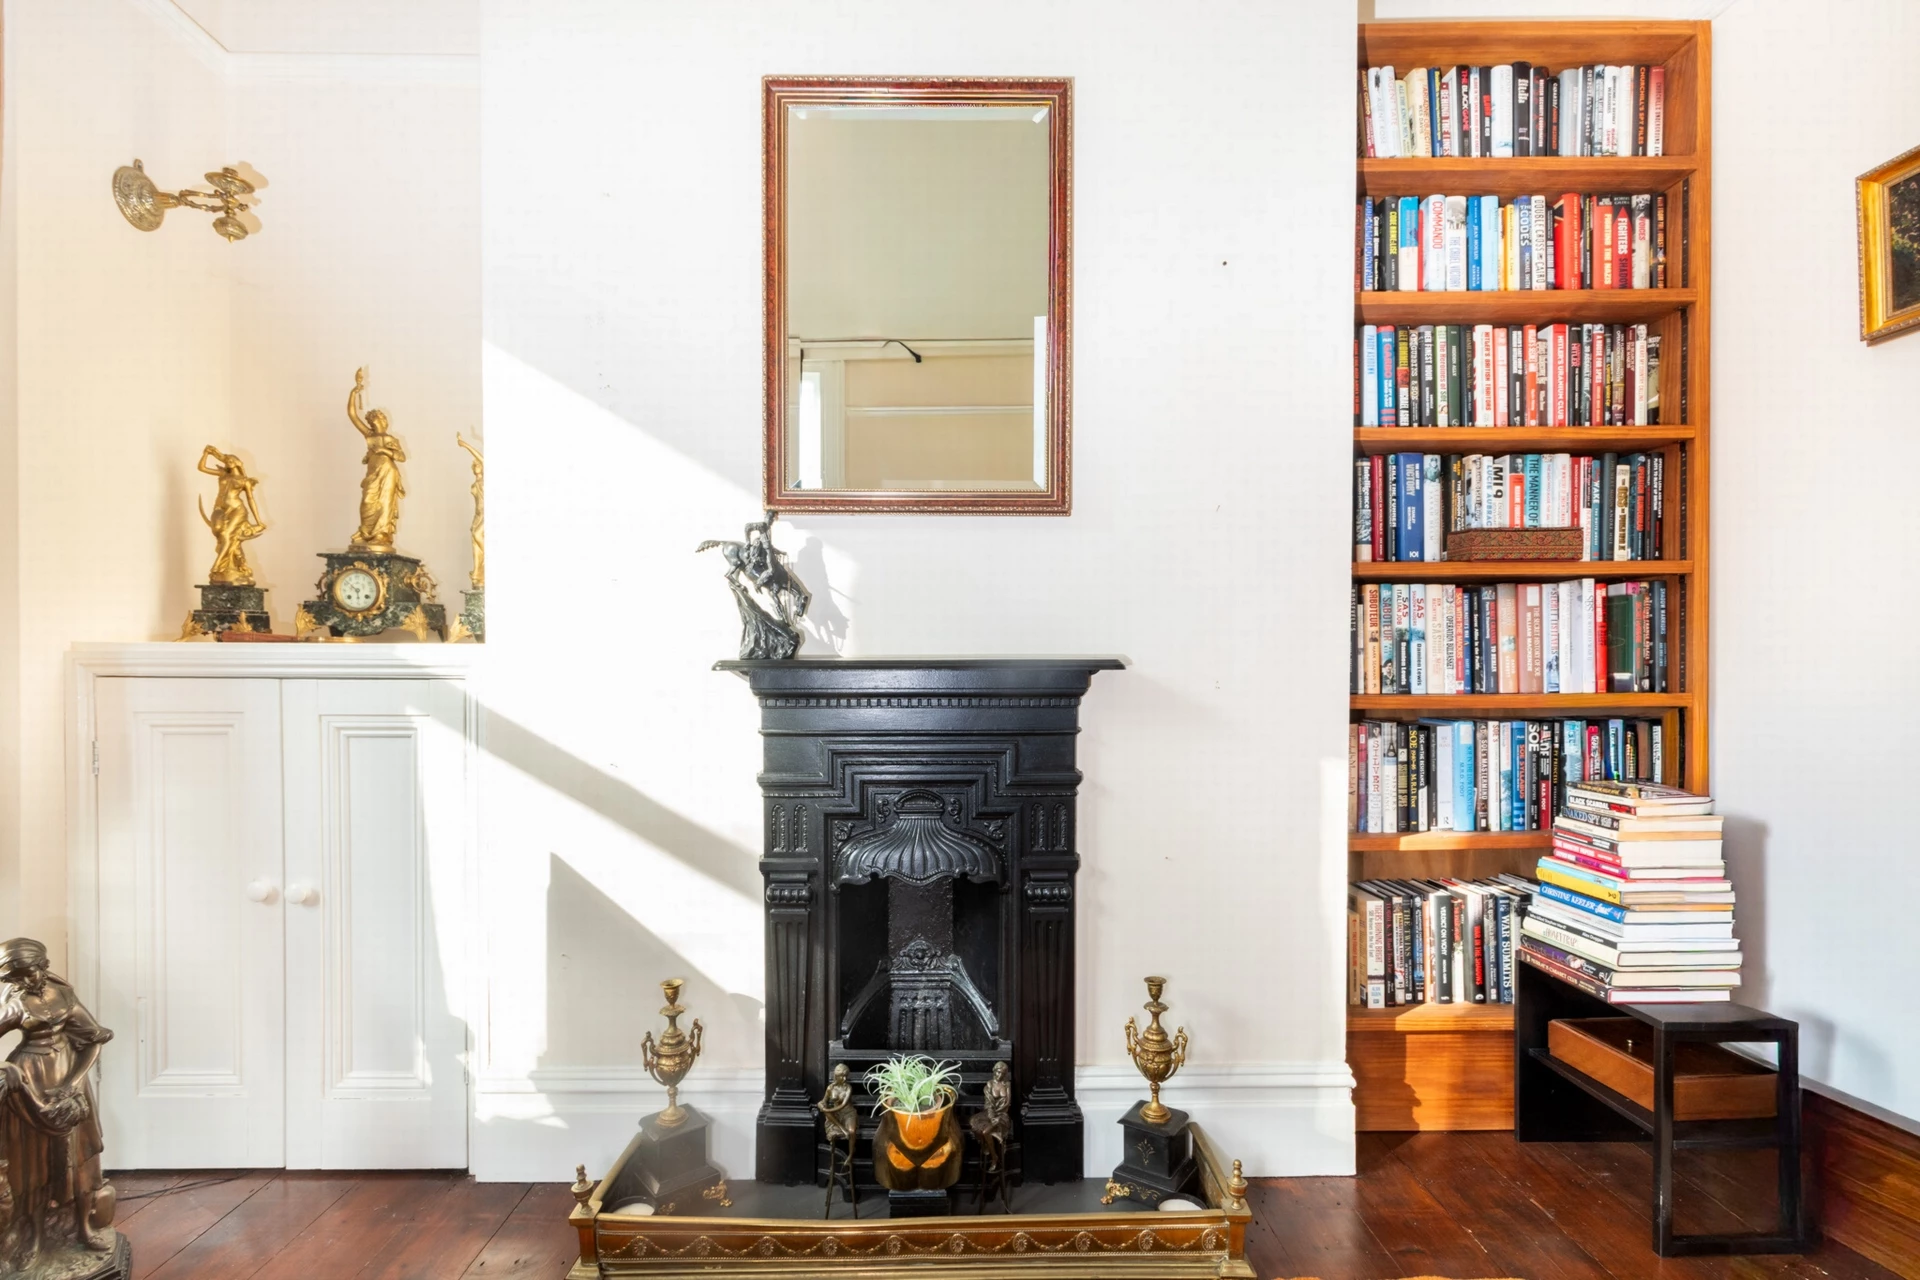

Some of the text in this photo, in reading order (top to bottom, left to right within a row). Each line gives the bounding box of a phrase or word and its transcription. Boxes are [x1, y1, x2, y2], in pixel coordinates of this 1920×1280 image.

[1432, 201, 1443, 249] COMMANDO
[1520, 210, 1530, 246] CODES
[1535, 200, 1544, 227] DOUBLE
[1604, 214, 1612, 246] FIGHTING
[1535, 230, 1544, 251] CROSS
[1604, 248, 1612, 260] THE
[1618, 218, 1628, 289] FIGHTERS SHADOW
[1604, 263, 1612, 284] NAZIS
[1384, 344, 1392, 378] GARBO
[1424, 331, 1433, 381] HER FINEST HOUR
[1362, 466, 1371, 509] Intelligence
[1406, 464, 1416, 496] VICTORY
[1528, 458, 1540, 523] THE MANNER OF
[1369, 590, 1378, 628] SABOTEUR
[1382, 598, 1392, 641] SABOTEUR
[1432, 623, 1442, 640] SAS
[1446, 616, 1454, 670] OPERATION BULBASKET
[1410, 730, 1418, 748] SOE
[1528, 724, 1540, 752] SOE
[1502, 915, 1512, 988] WAR SUMMITS
